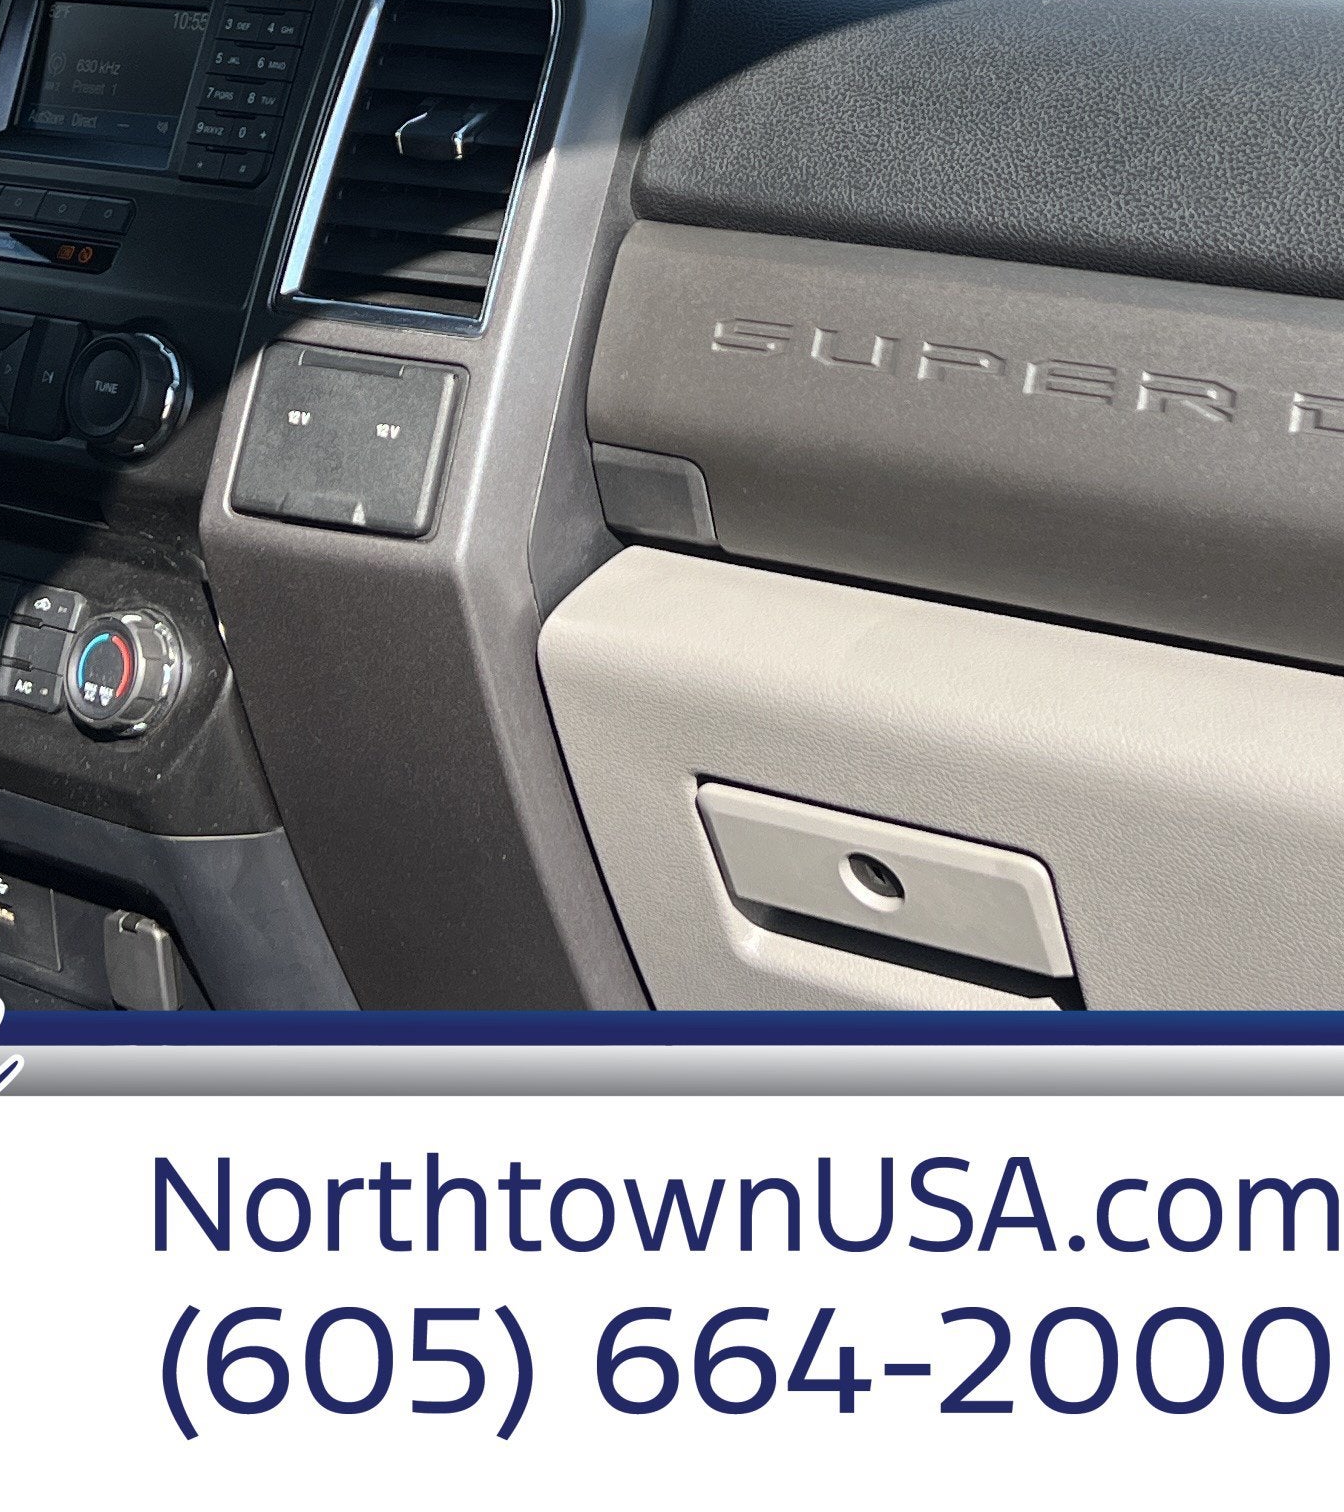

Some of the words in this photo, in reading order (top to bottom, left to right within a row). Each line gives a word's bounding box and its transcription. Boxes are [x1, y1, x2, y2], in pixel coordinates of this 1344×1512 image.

[224, 18, 234, 30] 3
[267, 22, 276, 33] 4
[215, 52, 224, 64] 5
[257, 56, 266, 69] 6
[207, 87, 215, 99] 7
[247, 92, 256, 104] 8
[195, 121, 204, 134] 9
[238, 126, 247, 139] 0
[709, 317, 1238, 424] SUPER
[94, 380, 119, 394] TUNE
